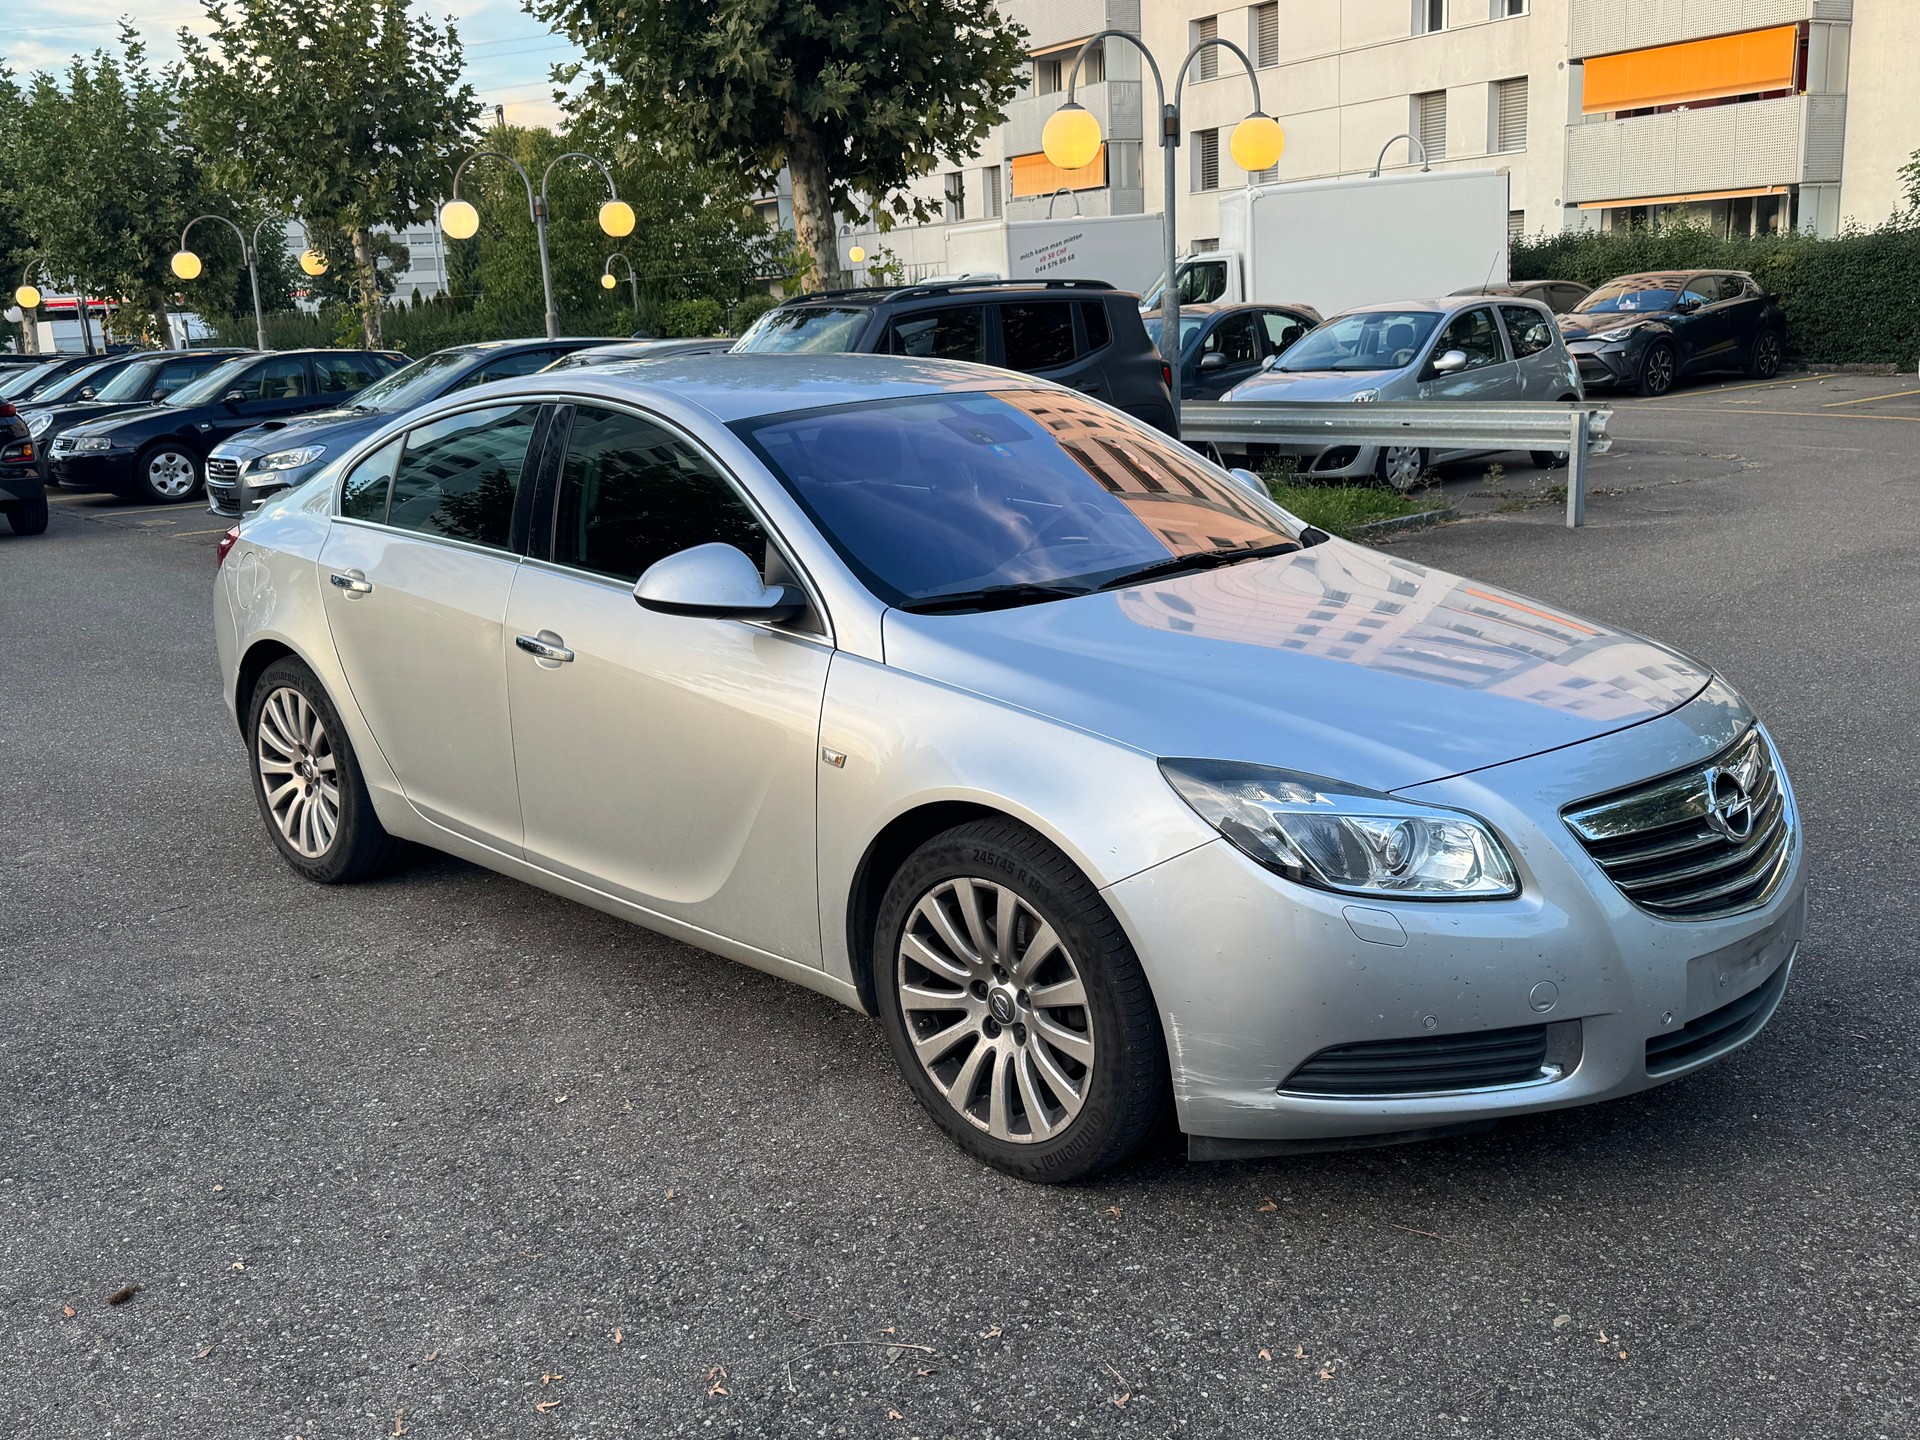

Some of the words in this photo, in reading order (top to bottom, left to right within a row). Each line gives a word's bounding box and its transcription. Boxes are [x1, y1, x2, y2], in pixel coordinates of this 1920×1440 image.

[1020, 251, 1033, 260] mich
[1035, 246, 1049, 254] kann
[1050, 241, 1062, 249] man
[1063, 233, 1082, 244] mieten
[1039, 255, 1046, 263] ab
[1056, 247, 1067, 256] CHF
[1035, 265, 1046, 273] 044
[1047, 260, 1058, 269] 576
[268, 671, 301, 687] Continental
[973, 849, 1016, 875] 245/45
[1018, 868, 1027, 883] R
[1029, 875, 1041, 894] 18
